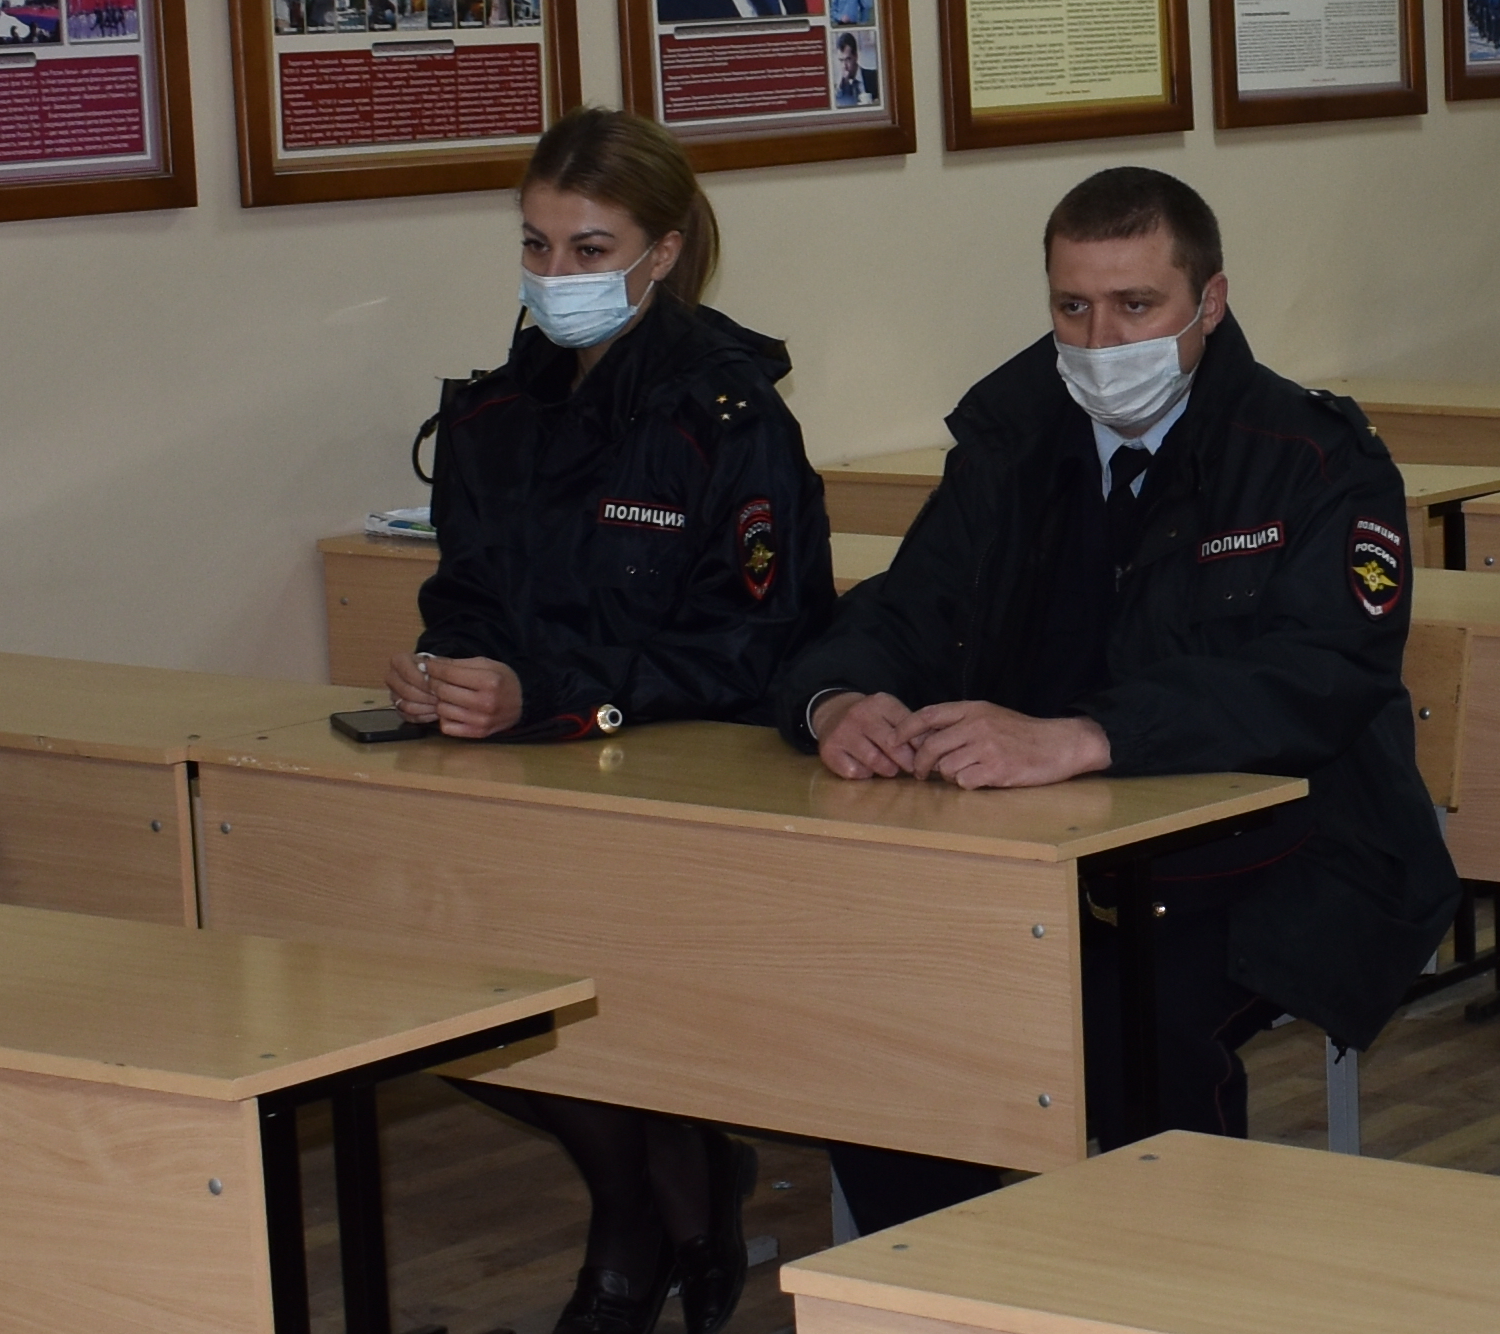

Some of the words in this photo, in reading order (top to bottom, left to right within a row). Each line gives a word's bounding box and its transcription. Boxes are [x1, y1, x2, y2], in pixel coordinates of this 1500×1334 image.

[605, 504, 685, 528] ПОЛИЦИЯ
[1201, 527, 1279, 558] ПОЛИЦИЯ
[1357, 520, 1401, 546] ПОЛИЦИЯ
[1355, 543, 1398, 568] РОССИЯ
